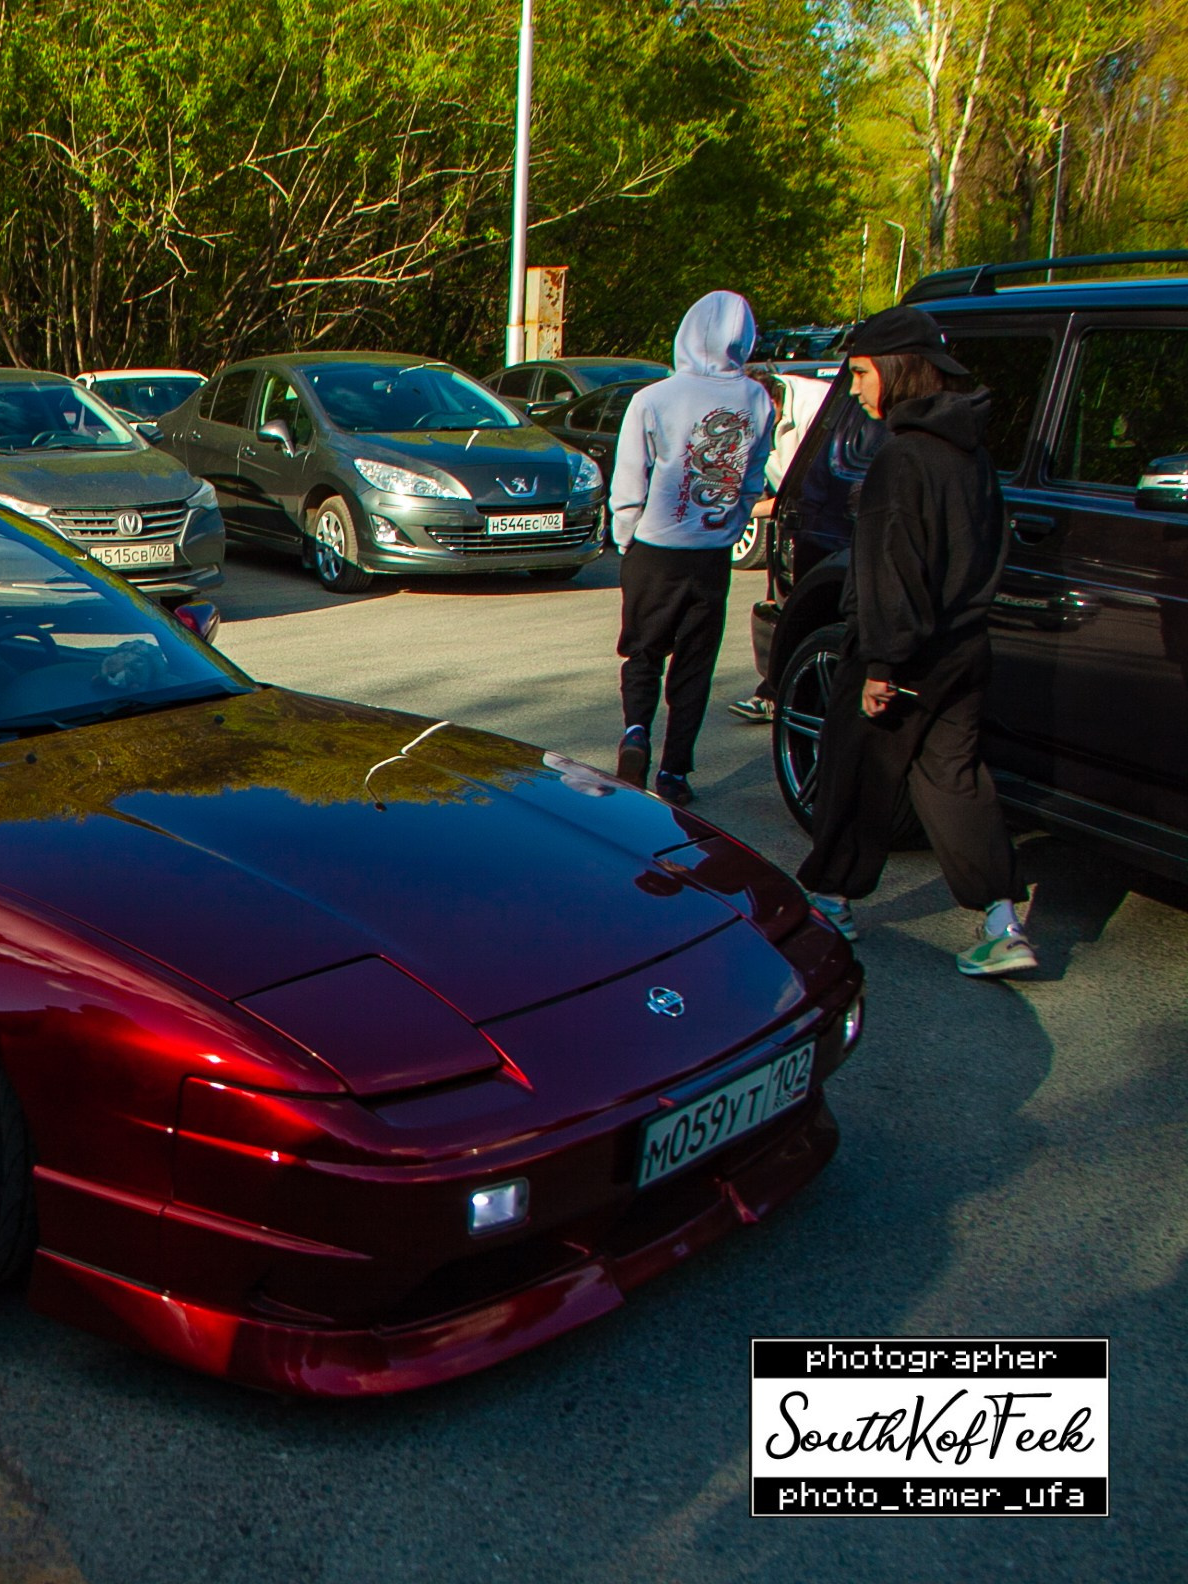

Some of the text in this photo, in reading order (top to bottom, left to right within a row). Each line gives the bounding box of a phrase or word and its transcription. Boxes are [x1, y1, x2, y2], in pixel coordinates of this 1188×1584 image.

[542, 514, 560, 526] 702
[150, 545, 171, 557] 702
[772, 1047, 811, 1097] 102
